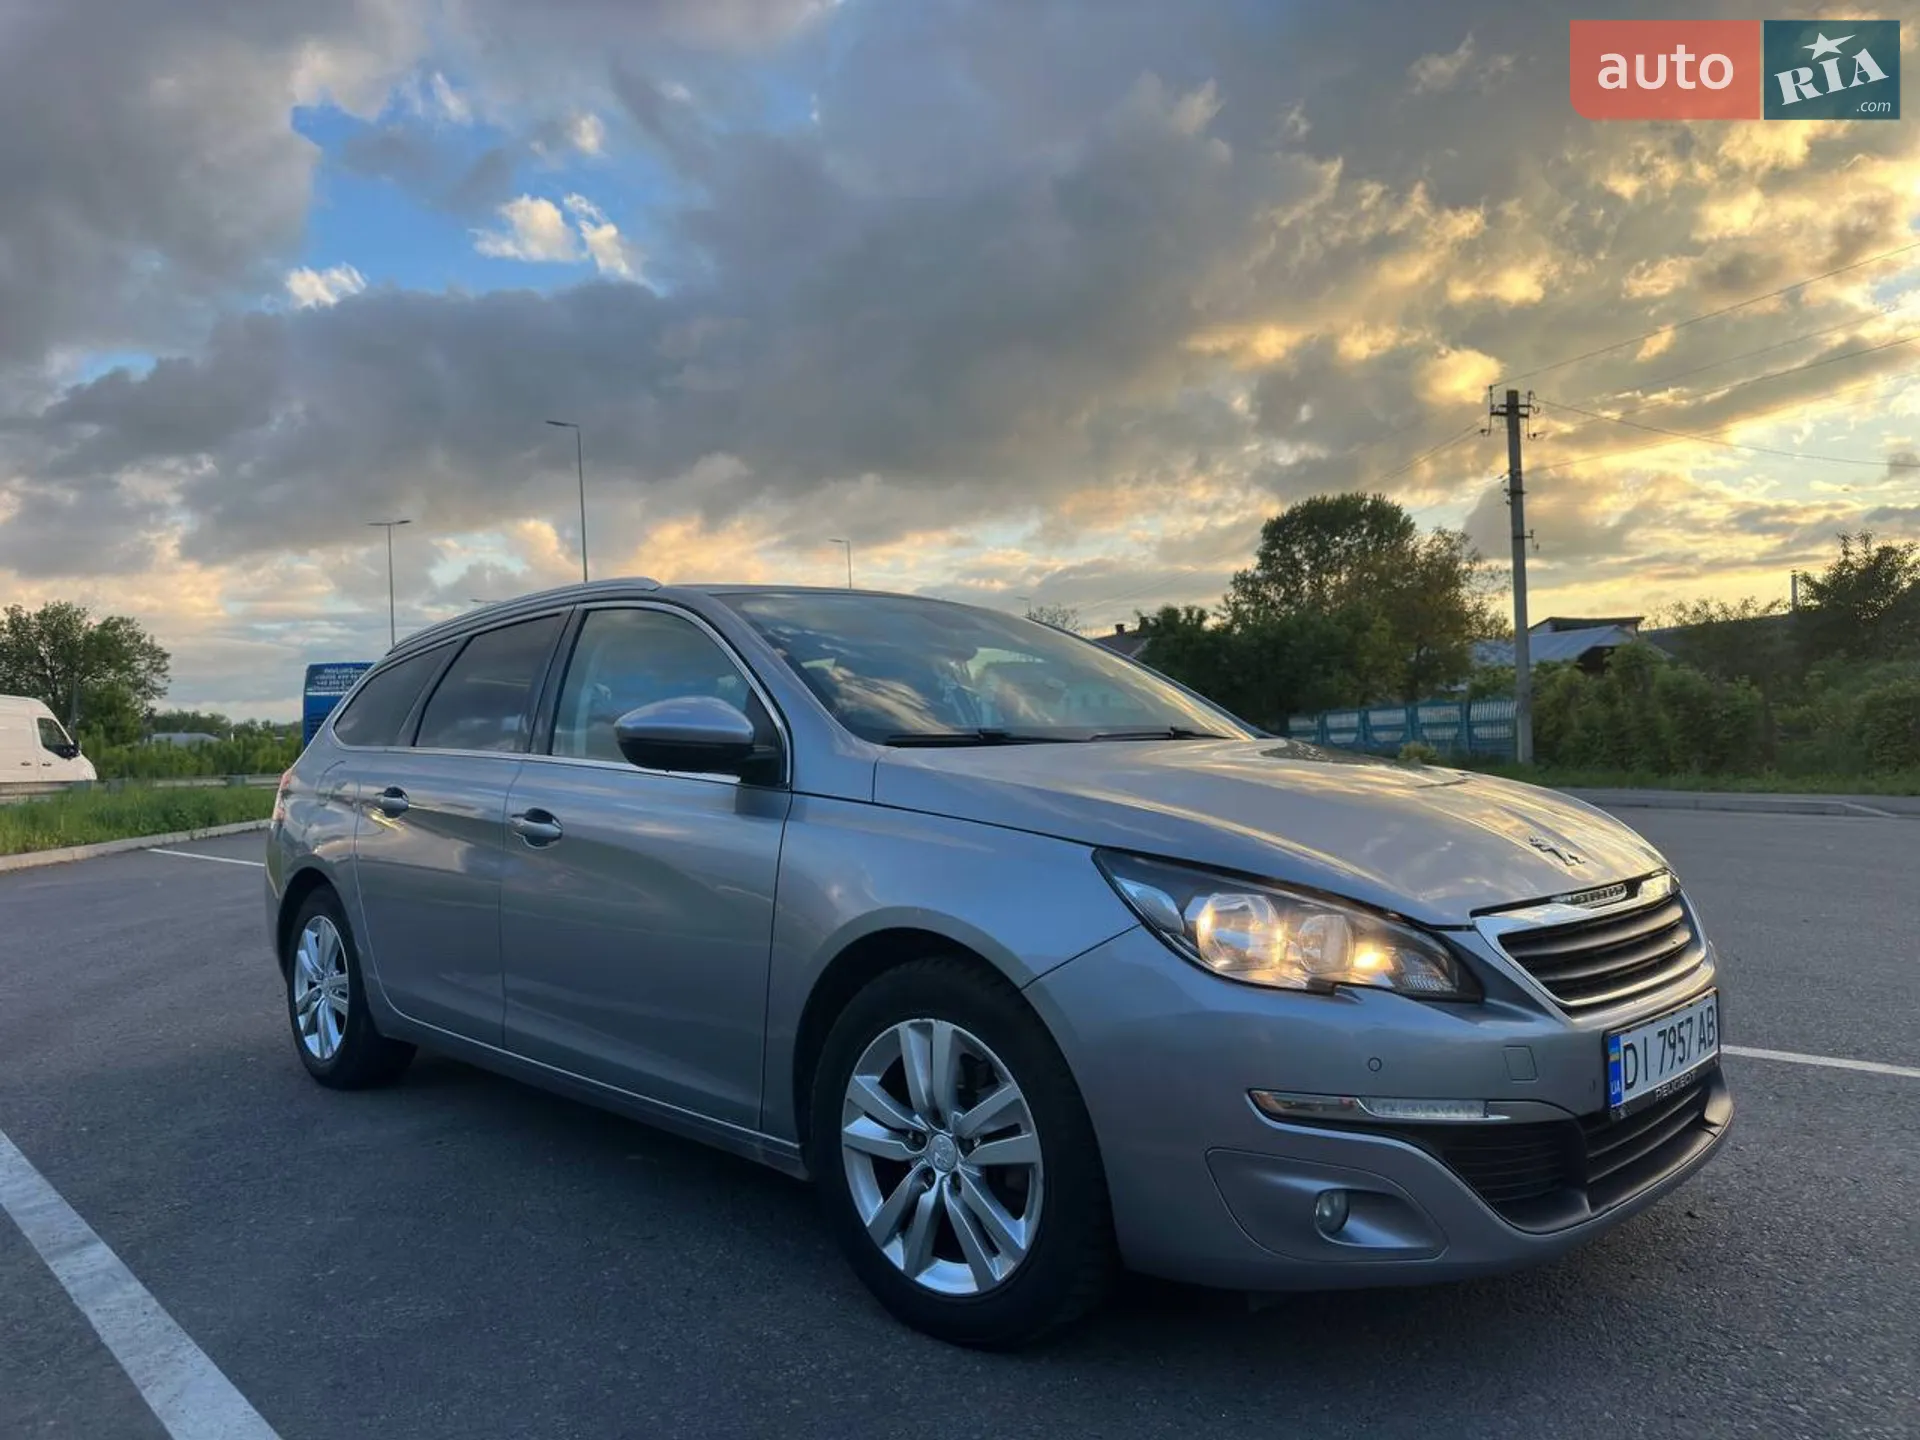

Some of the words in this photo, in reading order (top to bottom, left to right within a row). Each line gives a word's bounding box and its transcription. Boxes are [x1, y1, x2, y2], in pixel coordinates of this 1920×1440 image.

[1623, 1037, 1648, 1090] DI
[1657, 1017, 1693, 1077] 7957
[1697, 1005, 1716, 1056] AB
[1610, 1080, 1621, 1096] UA
[1655, 1071, 1697, 1102] PEUGEOT
